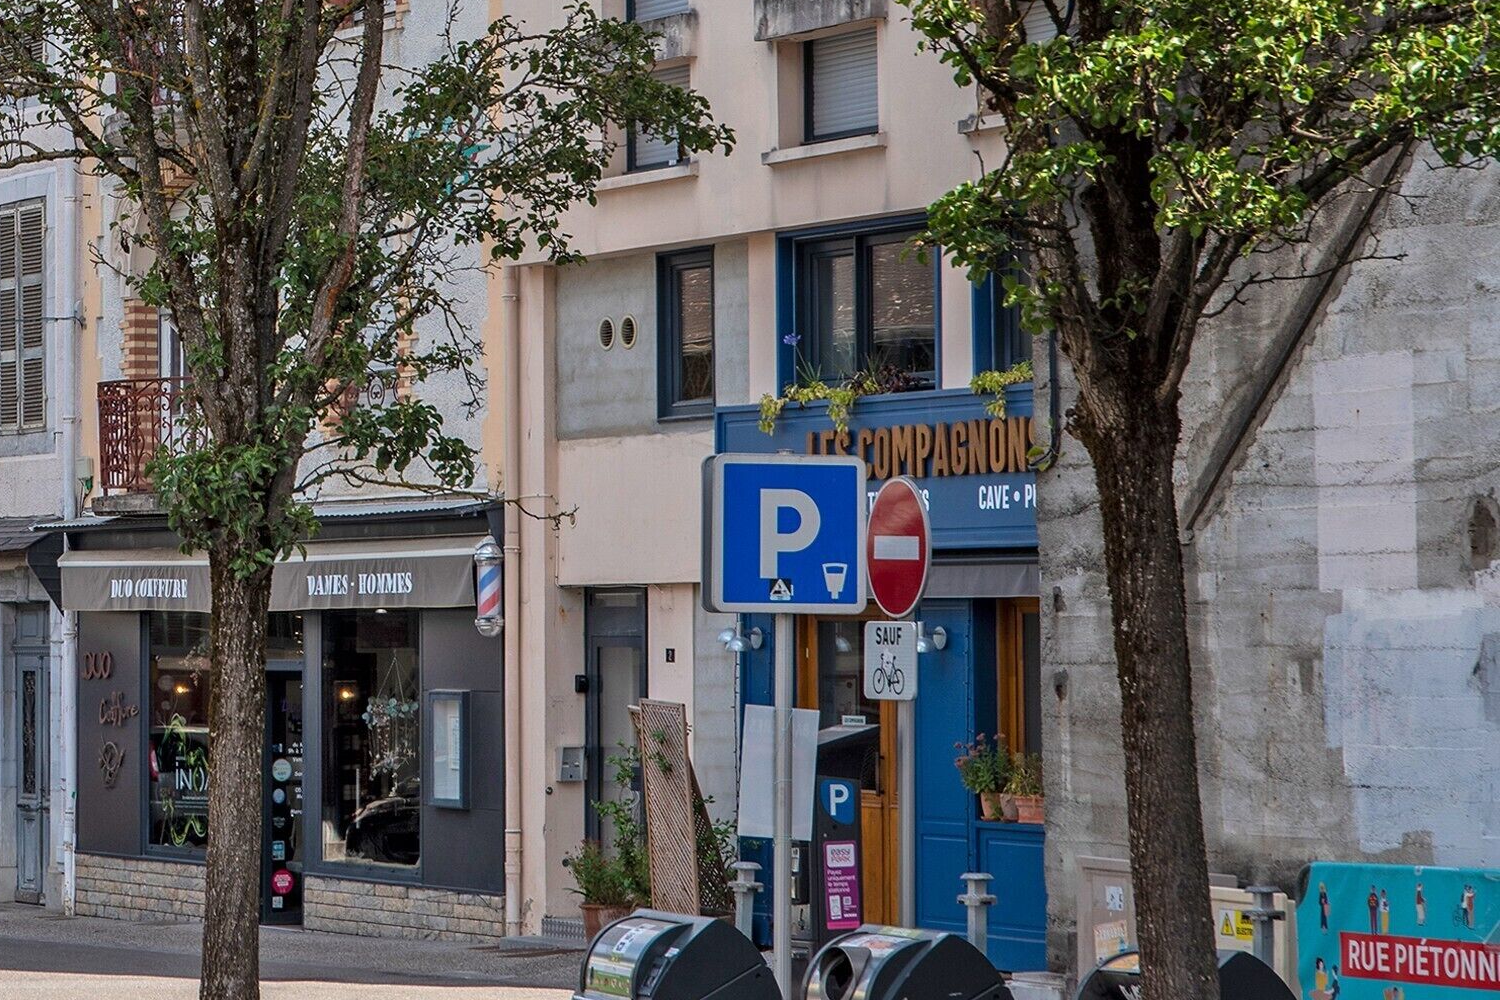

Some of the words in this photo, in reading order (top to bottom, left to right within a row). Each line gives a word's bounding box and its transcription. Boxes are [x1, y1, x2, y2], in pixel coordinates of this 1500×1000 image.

[978, 485, 1010, 510] CAVE
[759, 488, 821, 579] P
[110, 578, 133, 599] DUO
[135, 578, 188, 599] COIFFURE
[306, 574, 349, 596] DAMES
[357, 572, 413, 595] HOMMES
[875, 626, 902, 646] SAUF
[83, 651, 112, 680] DUO
[829, 783, 849, 816] P
[1348, 938, 1391, 972] RUE
